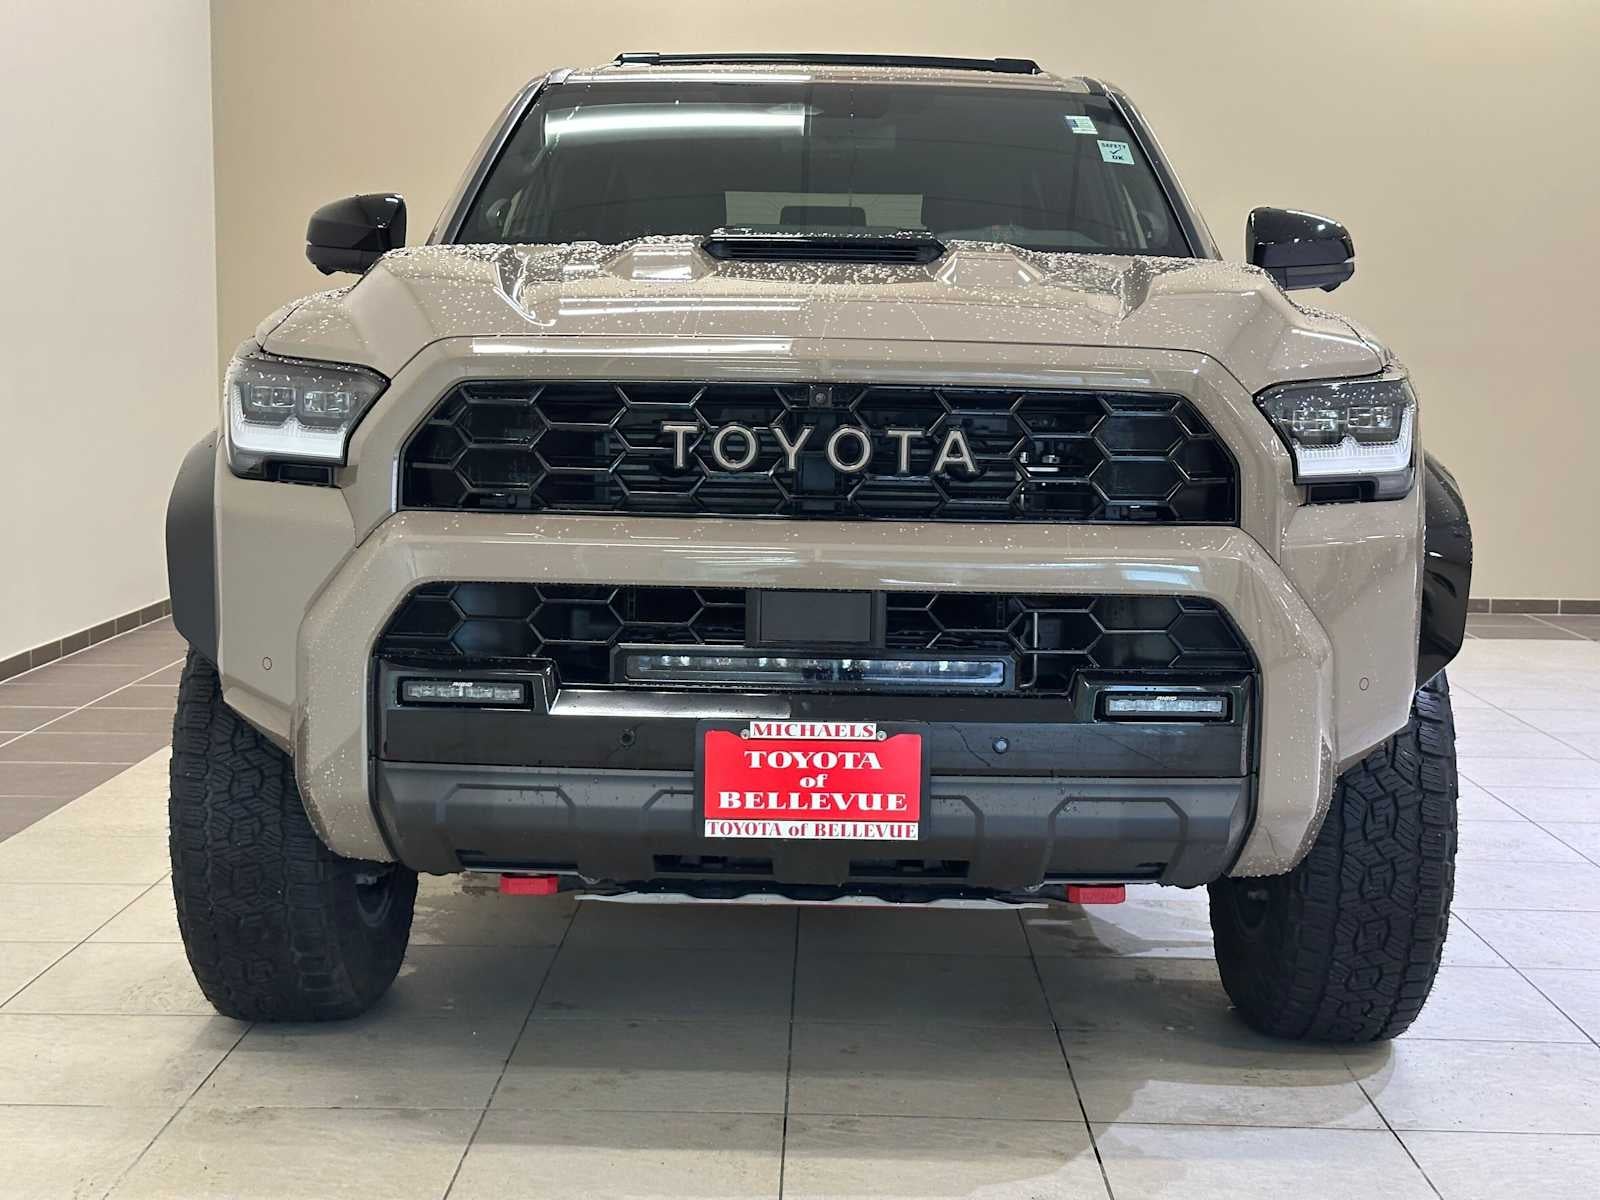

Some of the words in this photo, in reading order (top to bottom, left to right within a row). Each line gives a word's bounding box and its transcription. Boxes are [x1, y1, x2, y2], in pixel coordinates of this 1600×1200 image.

[661, 421, 978, 474] TOYOTA
[753, 723, 875, 738] MICHAELS
[744, 750, 883, 770] TOYOTA
[799, 774, 828, 788] of
[718, 792, 907, 811] BELLEVUE
[707, 821, 782, 836] TOYOTA
[788, 823, 808, 837] of
[815, 824, 917, 839] BELLEVUE
